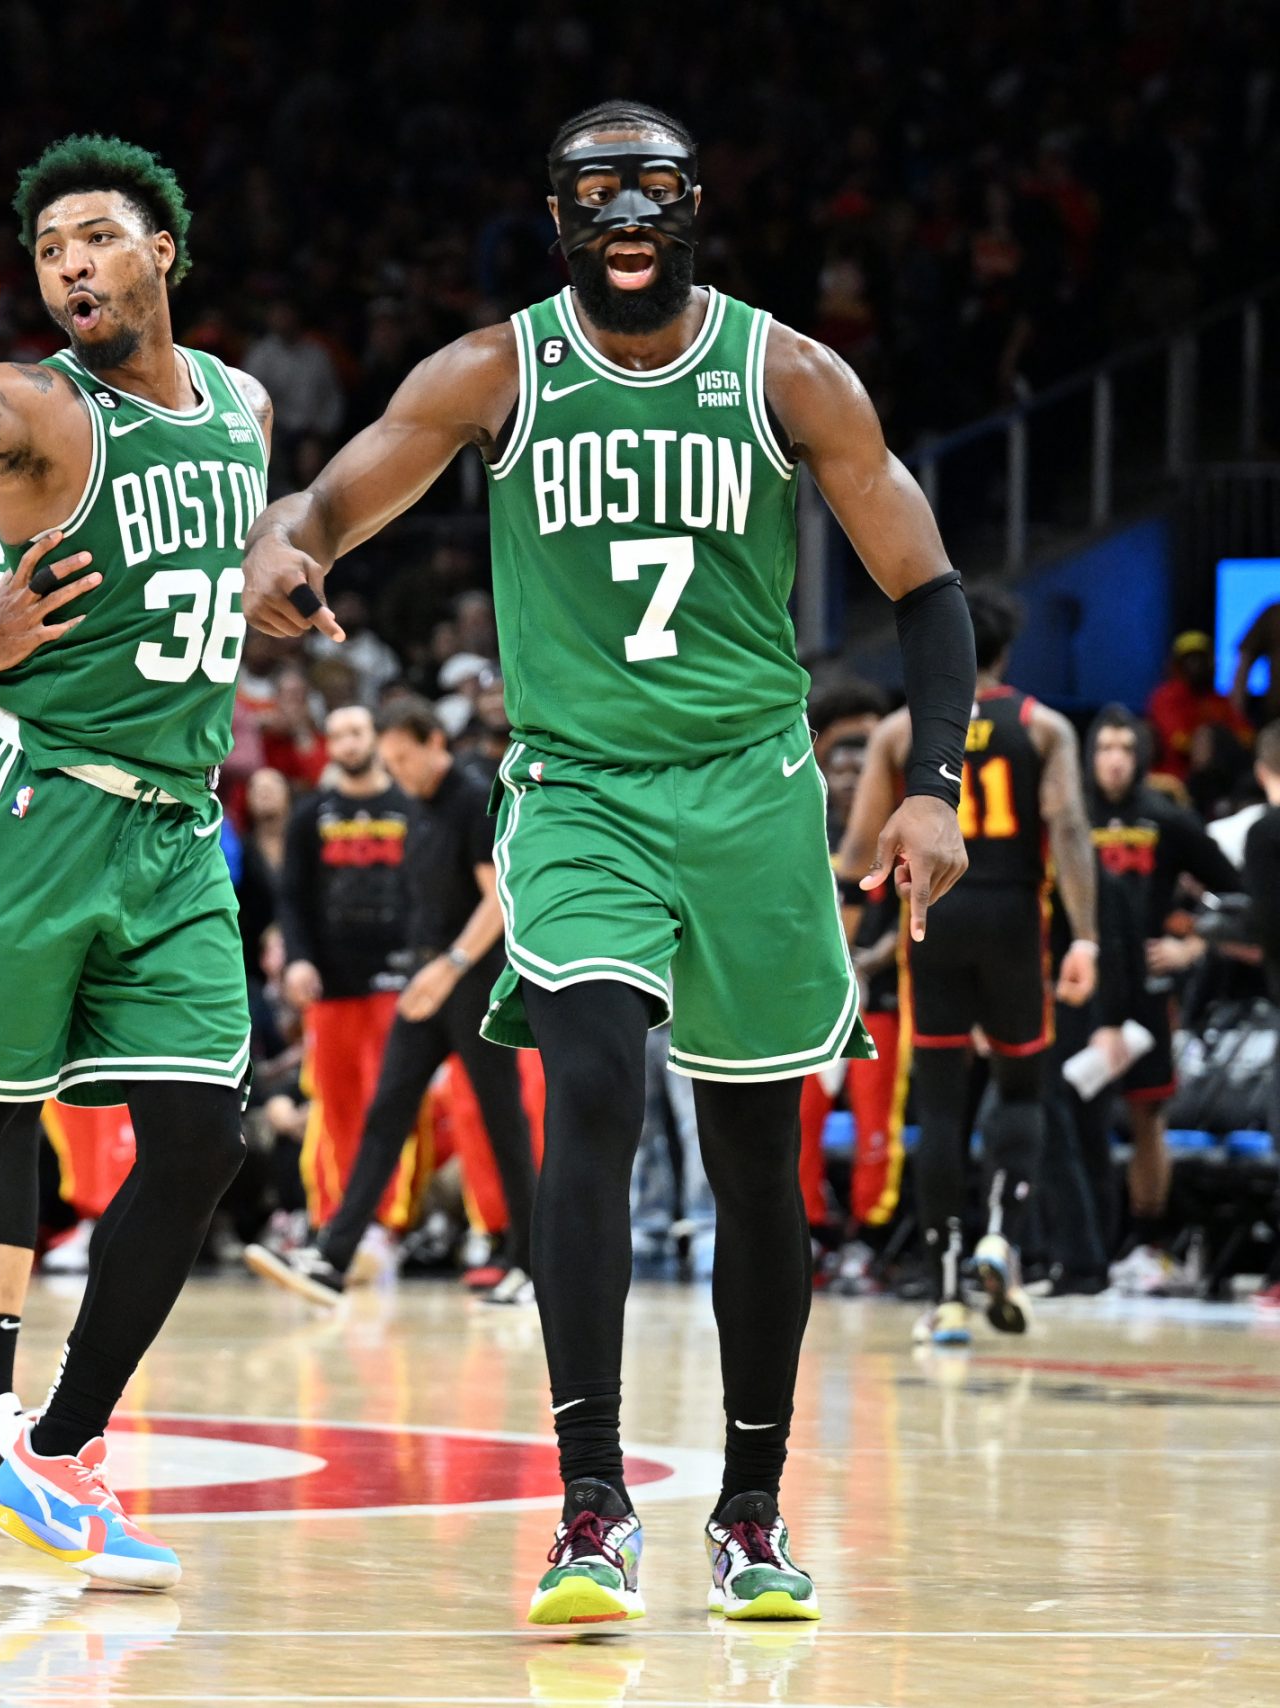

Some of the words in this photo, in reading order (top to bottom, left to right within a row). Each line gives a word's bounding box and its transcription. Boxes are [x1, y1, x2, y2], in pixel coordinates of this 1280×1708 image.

[543, 341, 564, 364] 6
[696, 370, 741, 391] VISTA
[95, 392, 116, 408] 6
[698, 392, 741, 408] PRINT
[220, 412, 250, 429] VISTA
[228, 429, 254, 444] PRINT
[533, 428, 752, 535] BOSTON
[609, 536, 695, 662] 7
[135, 567, 247, 683] 36
